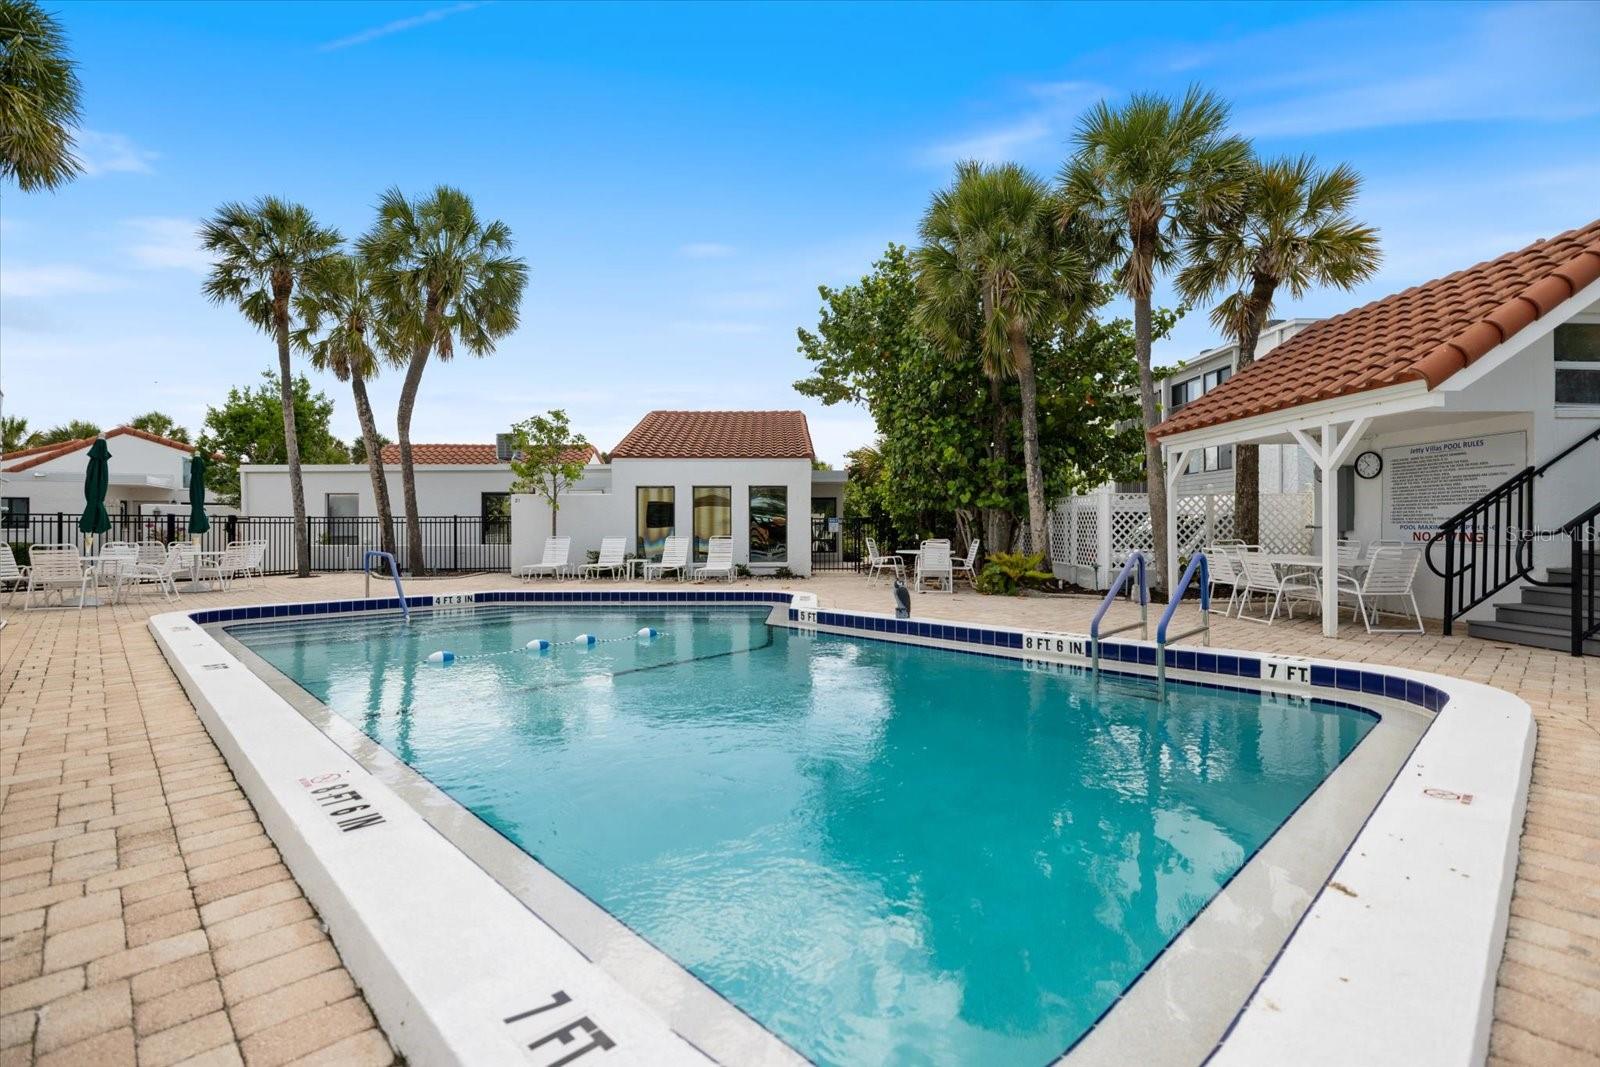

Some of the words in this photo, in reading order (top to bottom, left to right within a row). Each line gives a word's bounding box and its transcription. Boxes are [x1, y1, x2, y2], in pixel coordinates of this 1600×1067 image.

[1426, 445, 1442, 453] Villas
[1443, 442, 1462, 450] POOL
[1463, 439, 1484, 449] RULES
[1412, 531, 1431, 542] NO
[456, 596, 462, 604] 3
[800, 611, 805, 620] 5
[1026, 637, 1033, 649] 8
[1056, 639, 1064, 652] 6
[1268, 663, 1277, 678] 7
[1287, 665, 1308, 683] FT.
[311, 783, 350, 794] 8
[329, 804, 371, 816] 6
[336, 812, 387, 832] IN
[503, 990, 573, 1024] 7
[528, 1016, 617, 1067] FT
